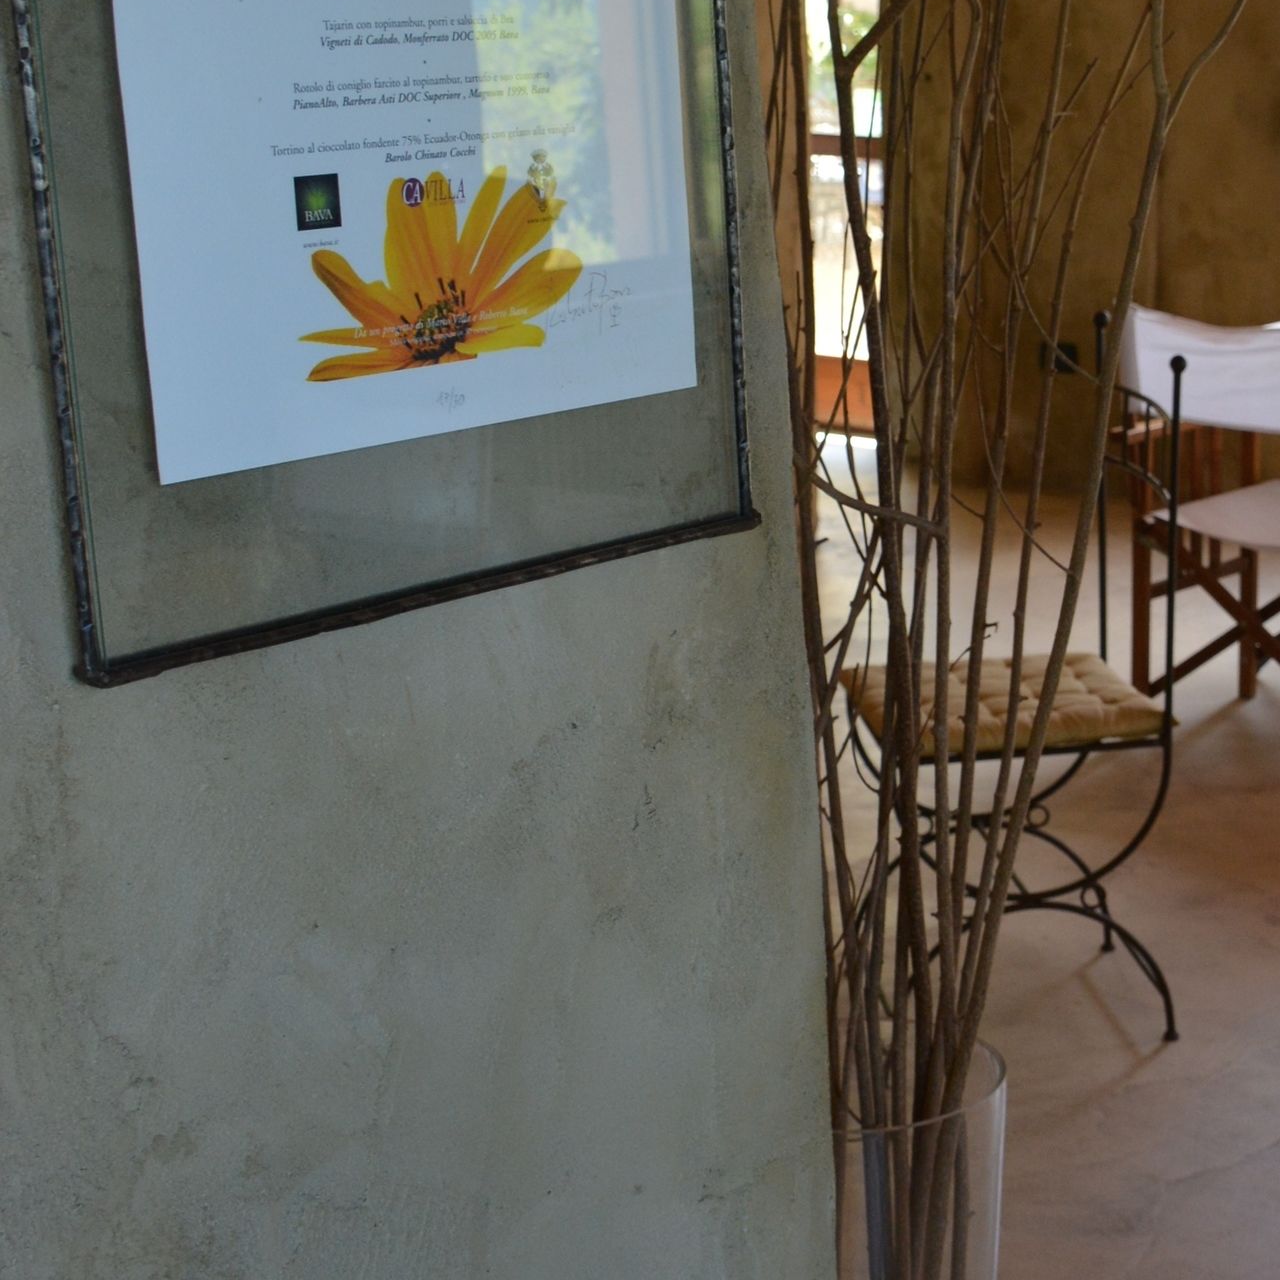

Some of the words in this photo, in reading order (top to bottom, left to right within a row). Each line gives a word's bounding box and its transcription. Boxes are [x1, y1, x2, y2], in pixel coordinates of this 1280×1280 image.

[356, 20, 372, 29] con
[320, 35, 351, 50] Vigneti
[353, 35, 363, 46] di
[402, 32, 449, 46] Monferrato
[451, 30, 474, 41] DOC
[293, 81, 323, 94] Rotolo
[325, 80, 335, 92] di
[337, 78, 372, 93] coniglio
[374, 77, 401, 89] farcito
[403, 76, 411, 87] al
[342, 94, 377, 107] Barbera
[378, 93, 396, 105] Asti
[398, 91, 422, 104] DOC
[270, 144, 305, 157] Tortino
[307, 142, 315, 154] al
[317, 140, 361, 153] cioccolato
[363, 137, 400, 150] fondente
[385, 150, 412, 163] Barolo
[304, 208, 334, 222] BAVA
